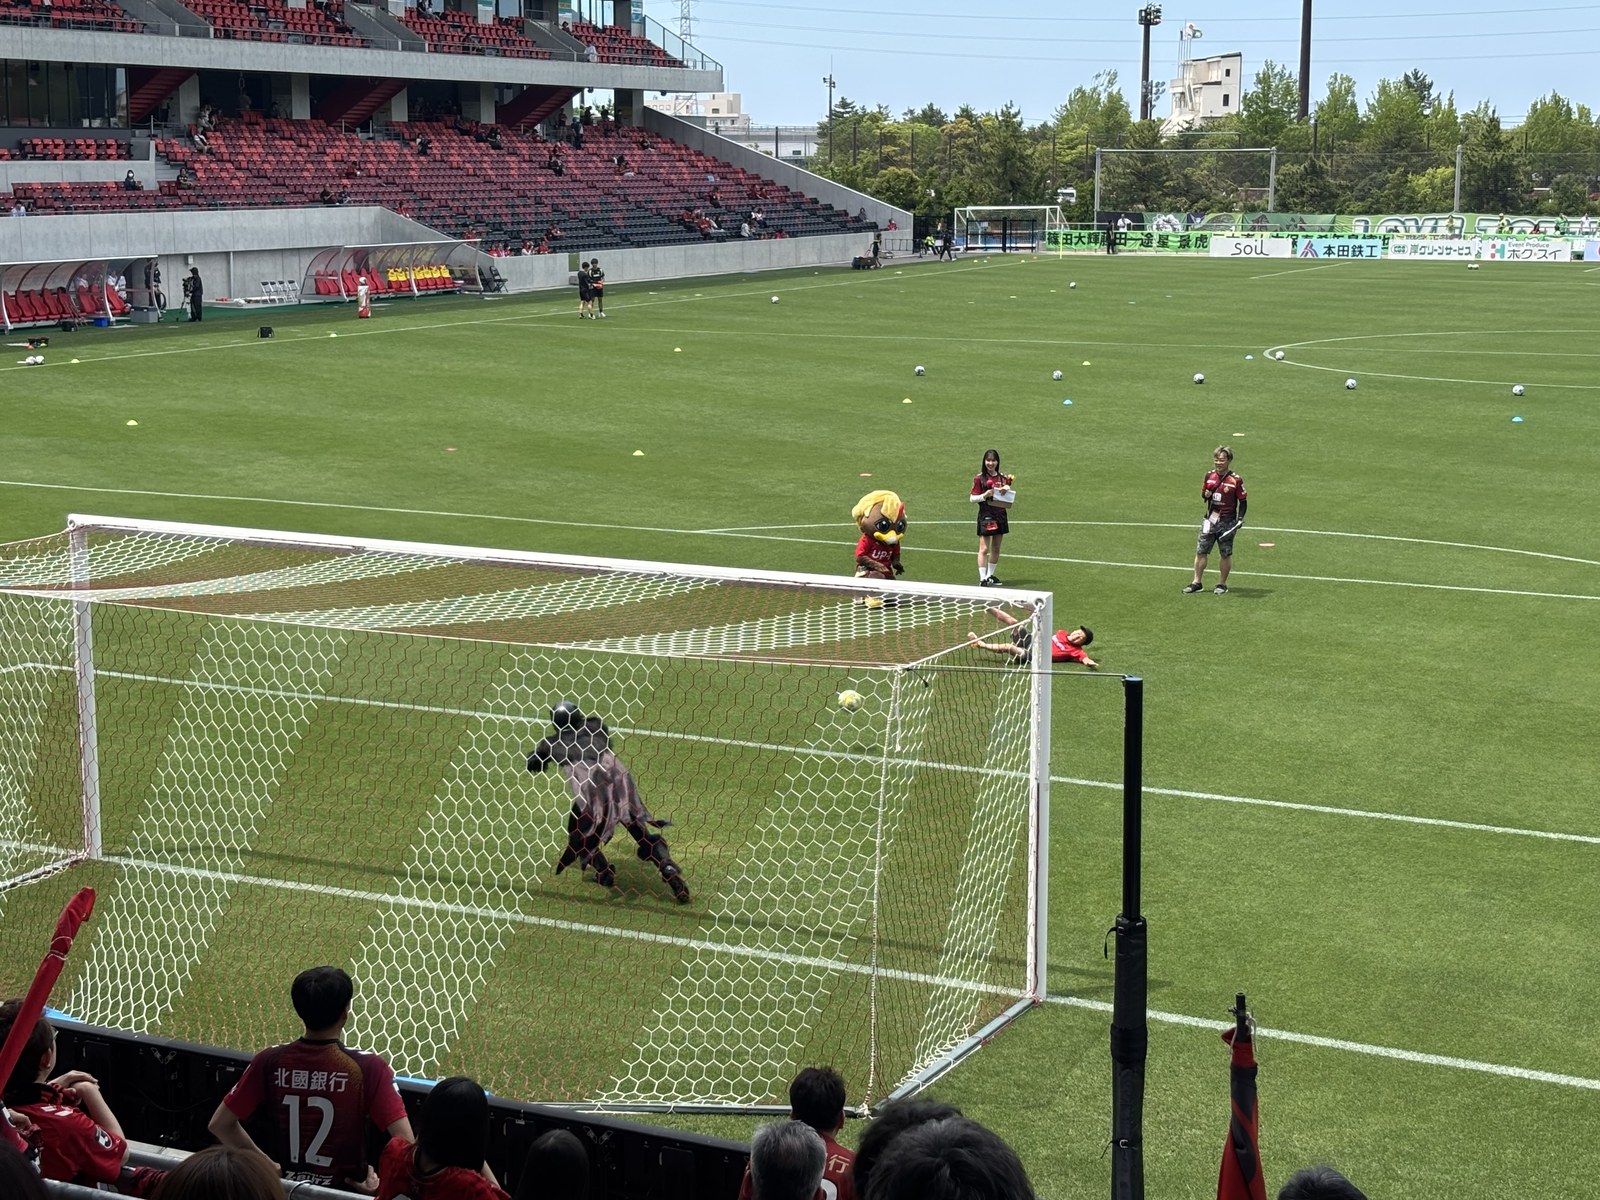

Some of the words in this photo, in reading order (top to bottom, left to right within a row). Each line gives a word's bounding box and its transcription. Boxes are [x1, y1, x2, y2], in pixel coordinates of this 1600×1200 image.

[1323, 244, 1378, 258] 本田鉄工
[274, 1067, 349, 1092] 北國銀行
[282, 1094, 335, 1167] 12
[826, 1153, 851, 1174] 行
